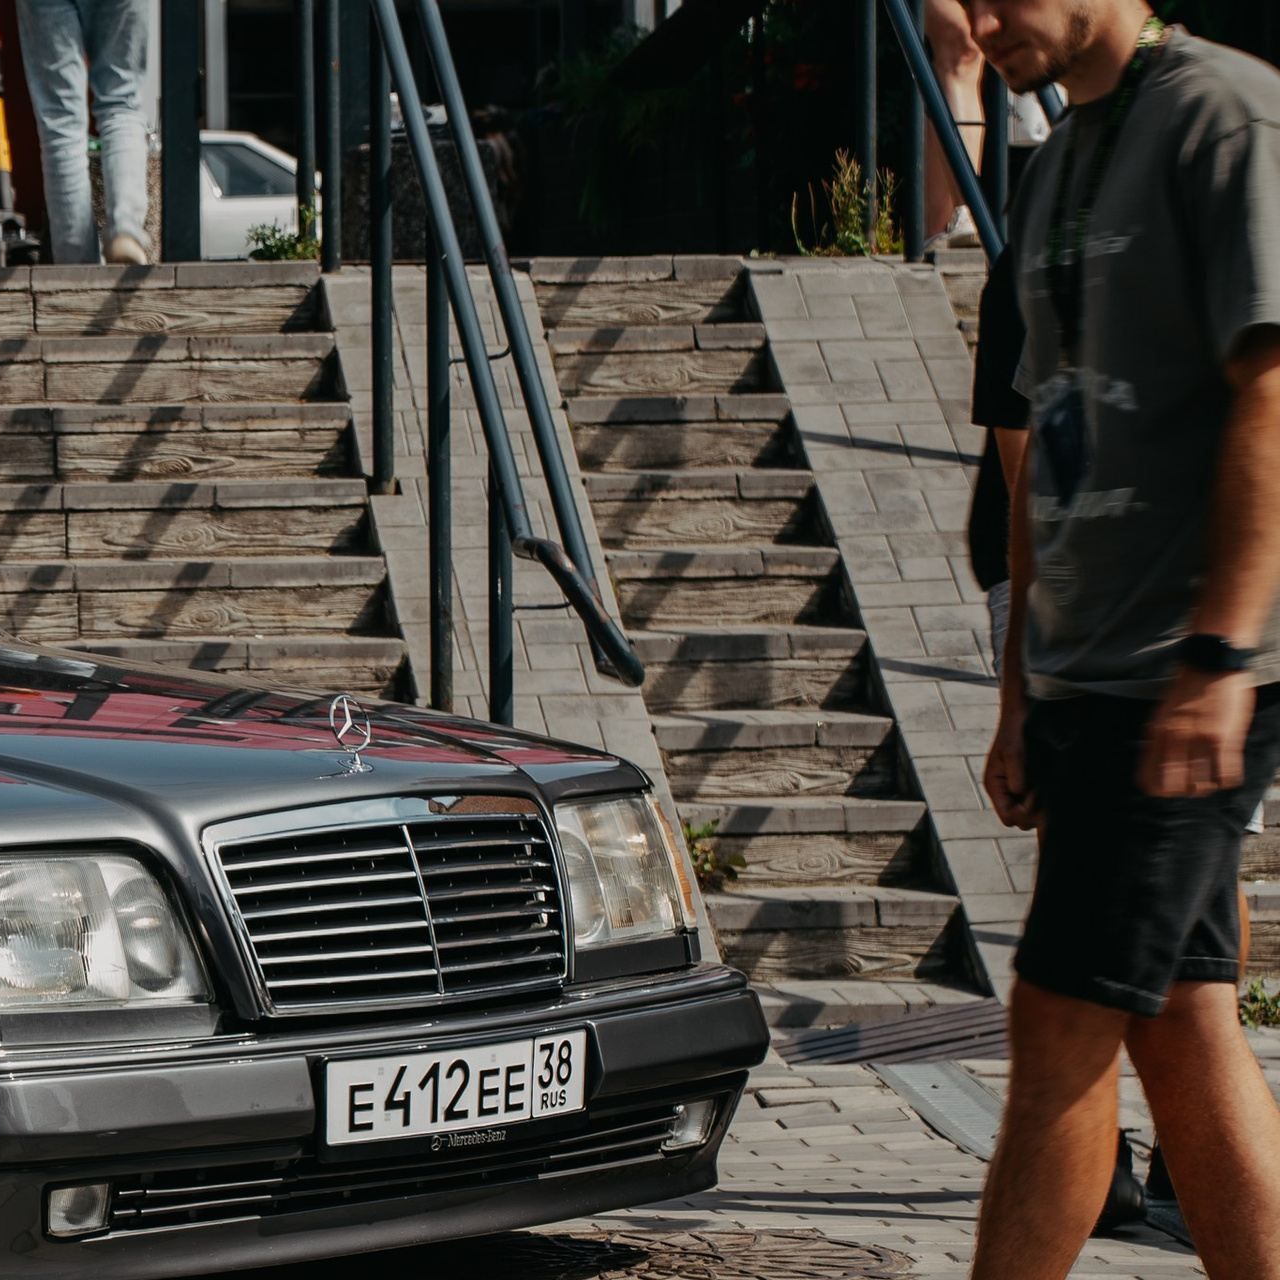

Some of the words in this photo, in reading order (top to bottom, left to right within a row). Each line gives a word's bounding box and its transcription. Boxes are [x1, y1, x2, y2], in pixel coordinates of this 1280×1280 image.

[348, 1058, 526, 1133] E412EE
[537, 1039, 573, 1090] 38
[540, 1089, 567, 1111] RUS
[447, 1129, 507, 1148] Mercedes-Benz
